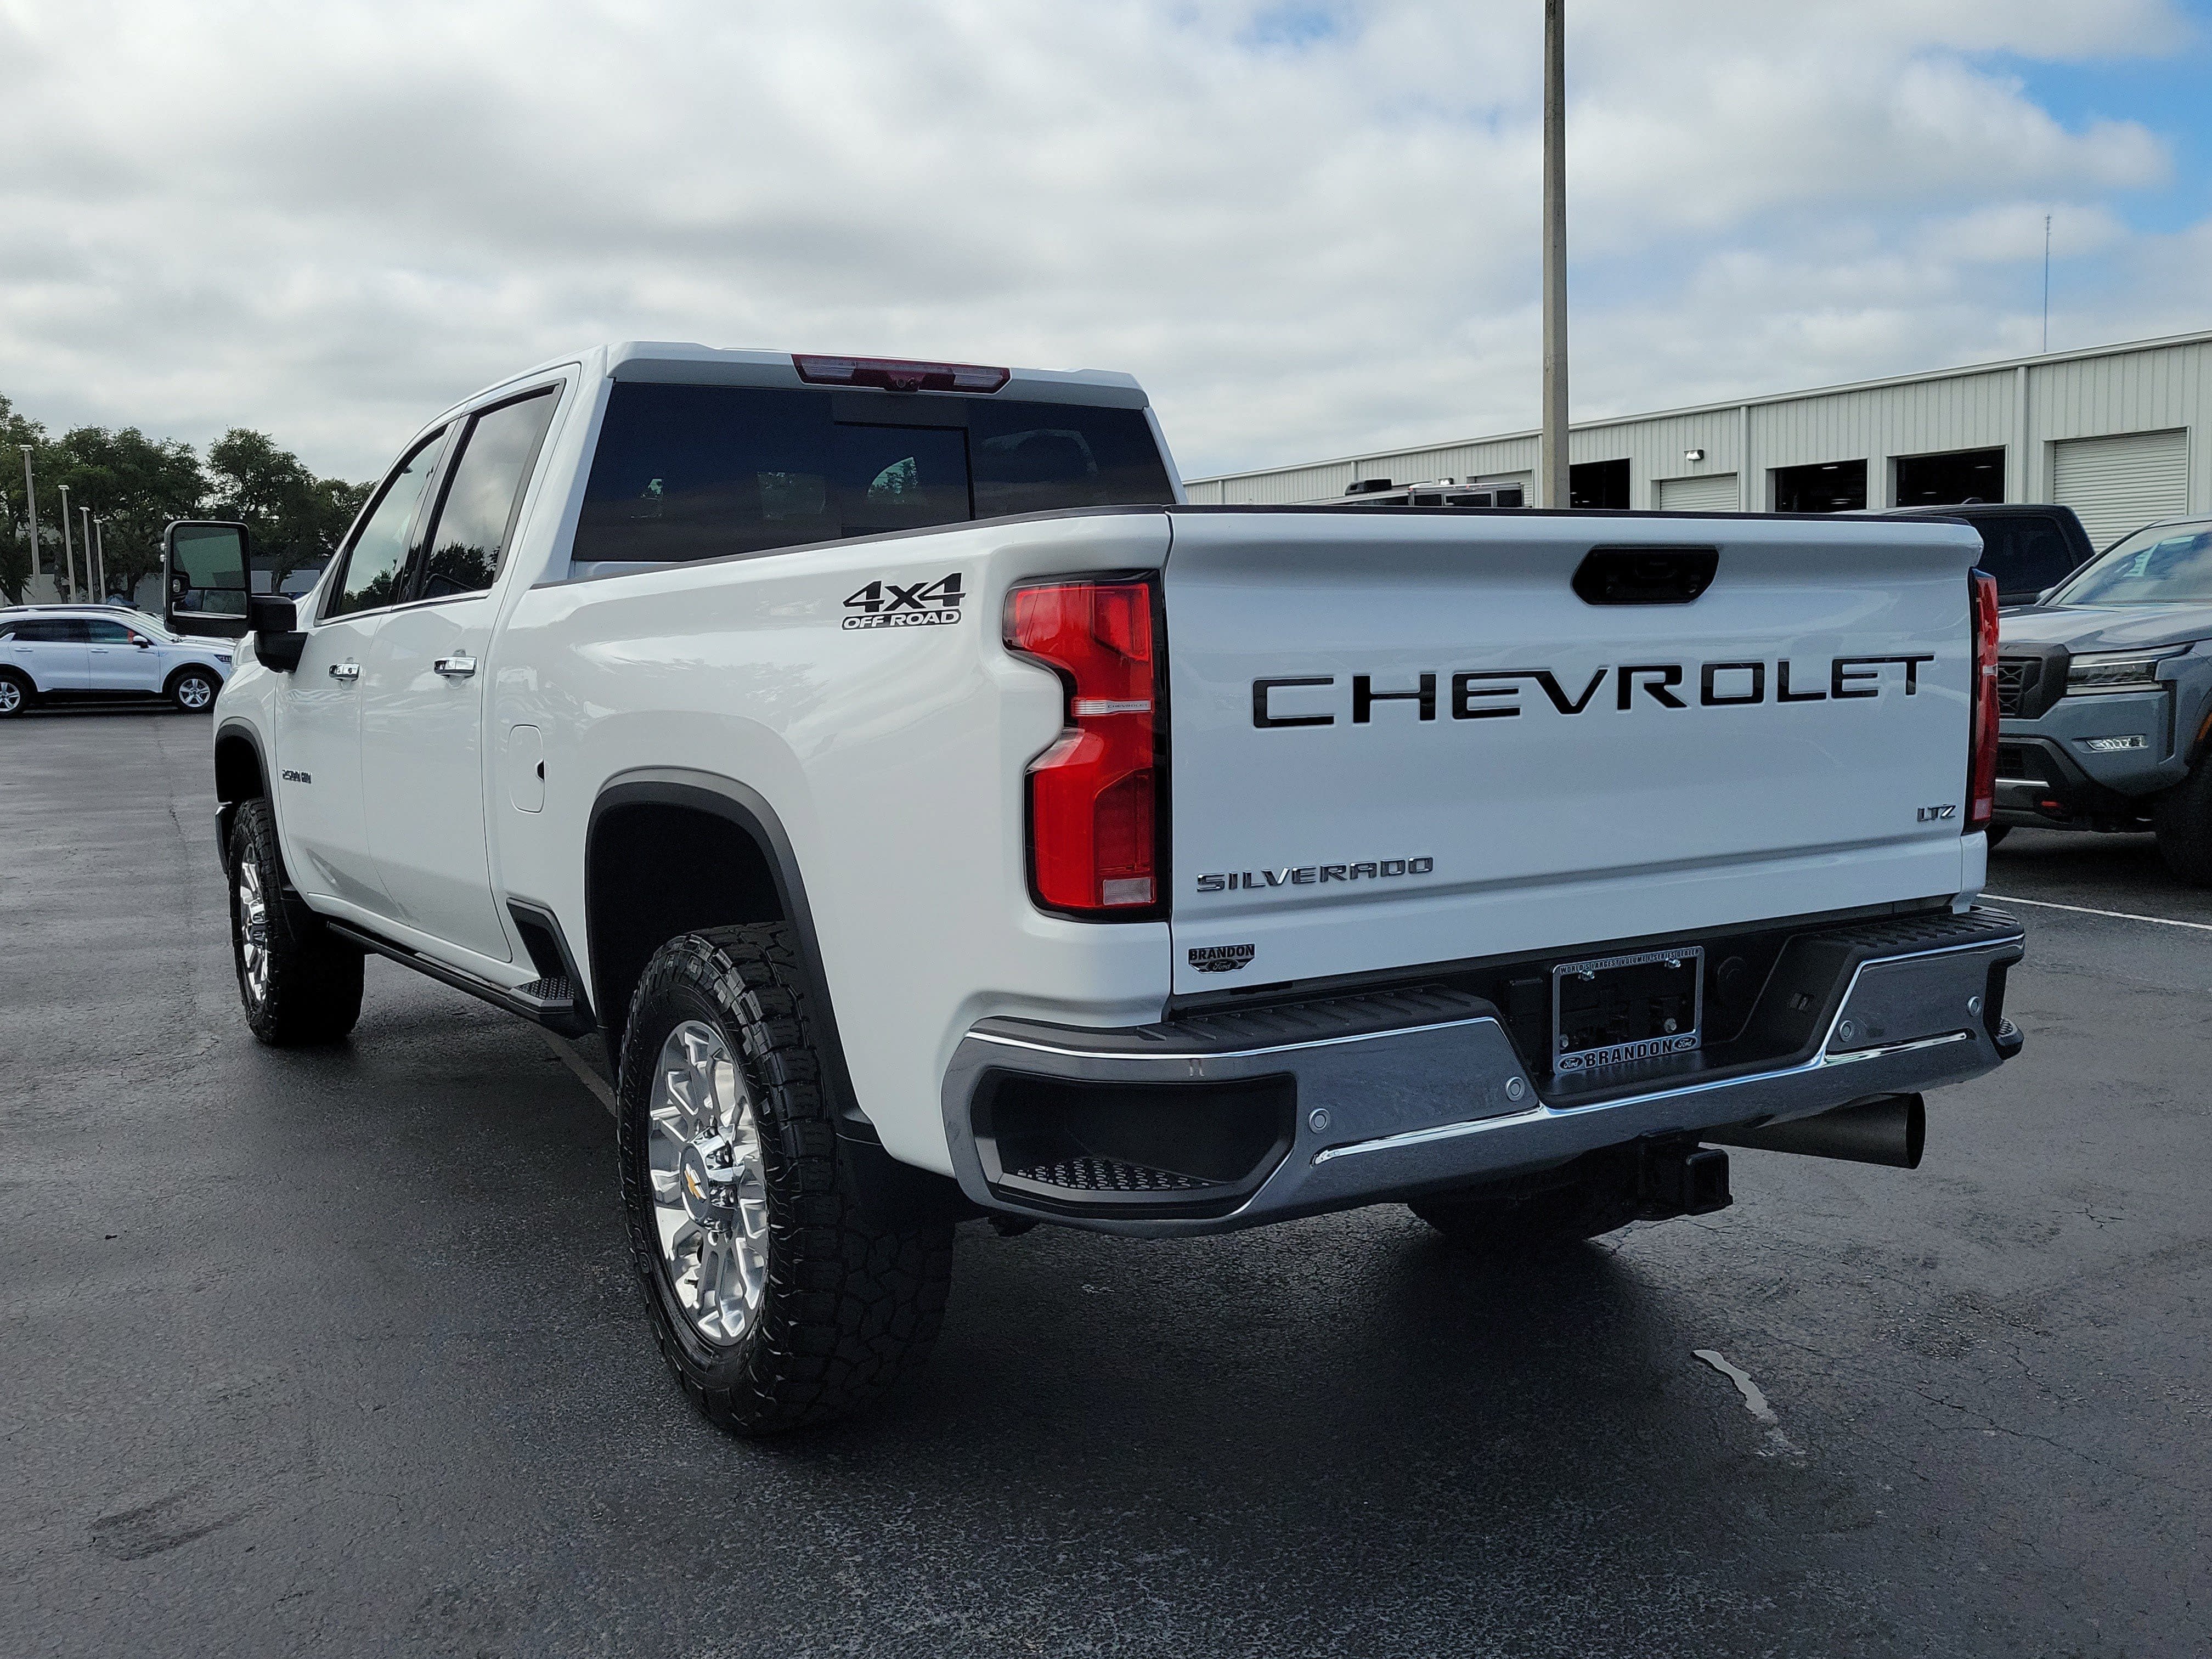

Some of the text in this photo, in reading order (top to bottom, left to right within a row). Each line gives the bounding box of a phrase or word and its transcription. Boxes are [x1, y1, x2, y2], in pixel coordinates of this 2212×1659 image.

[843, 610, 960, 629] OFF ROAD
[1253, 654, 1935, 729] CHEVROLET
[1917, 804, 1956, 822] LTZ
[1196, 856, 1434, 892] SILVERADO
[1189, 944, 1255, 961] BRANDON
[1592, 959, 1620, 970] LARGEST
[1621, 956, 1645, 966] VOLUME
[1677, 949, 1699, 957] DEALER
[1212, 961, 1232, 970] Ford
[1563, 1039, 1694, 1069] Ford BRANDON Ford
